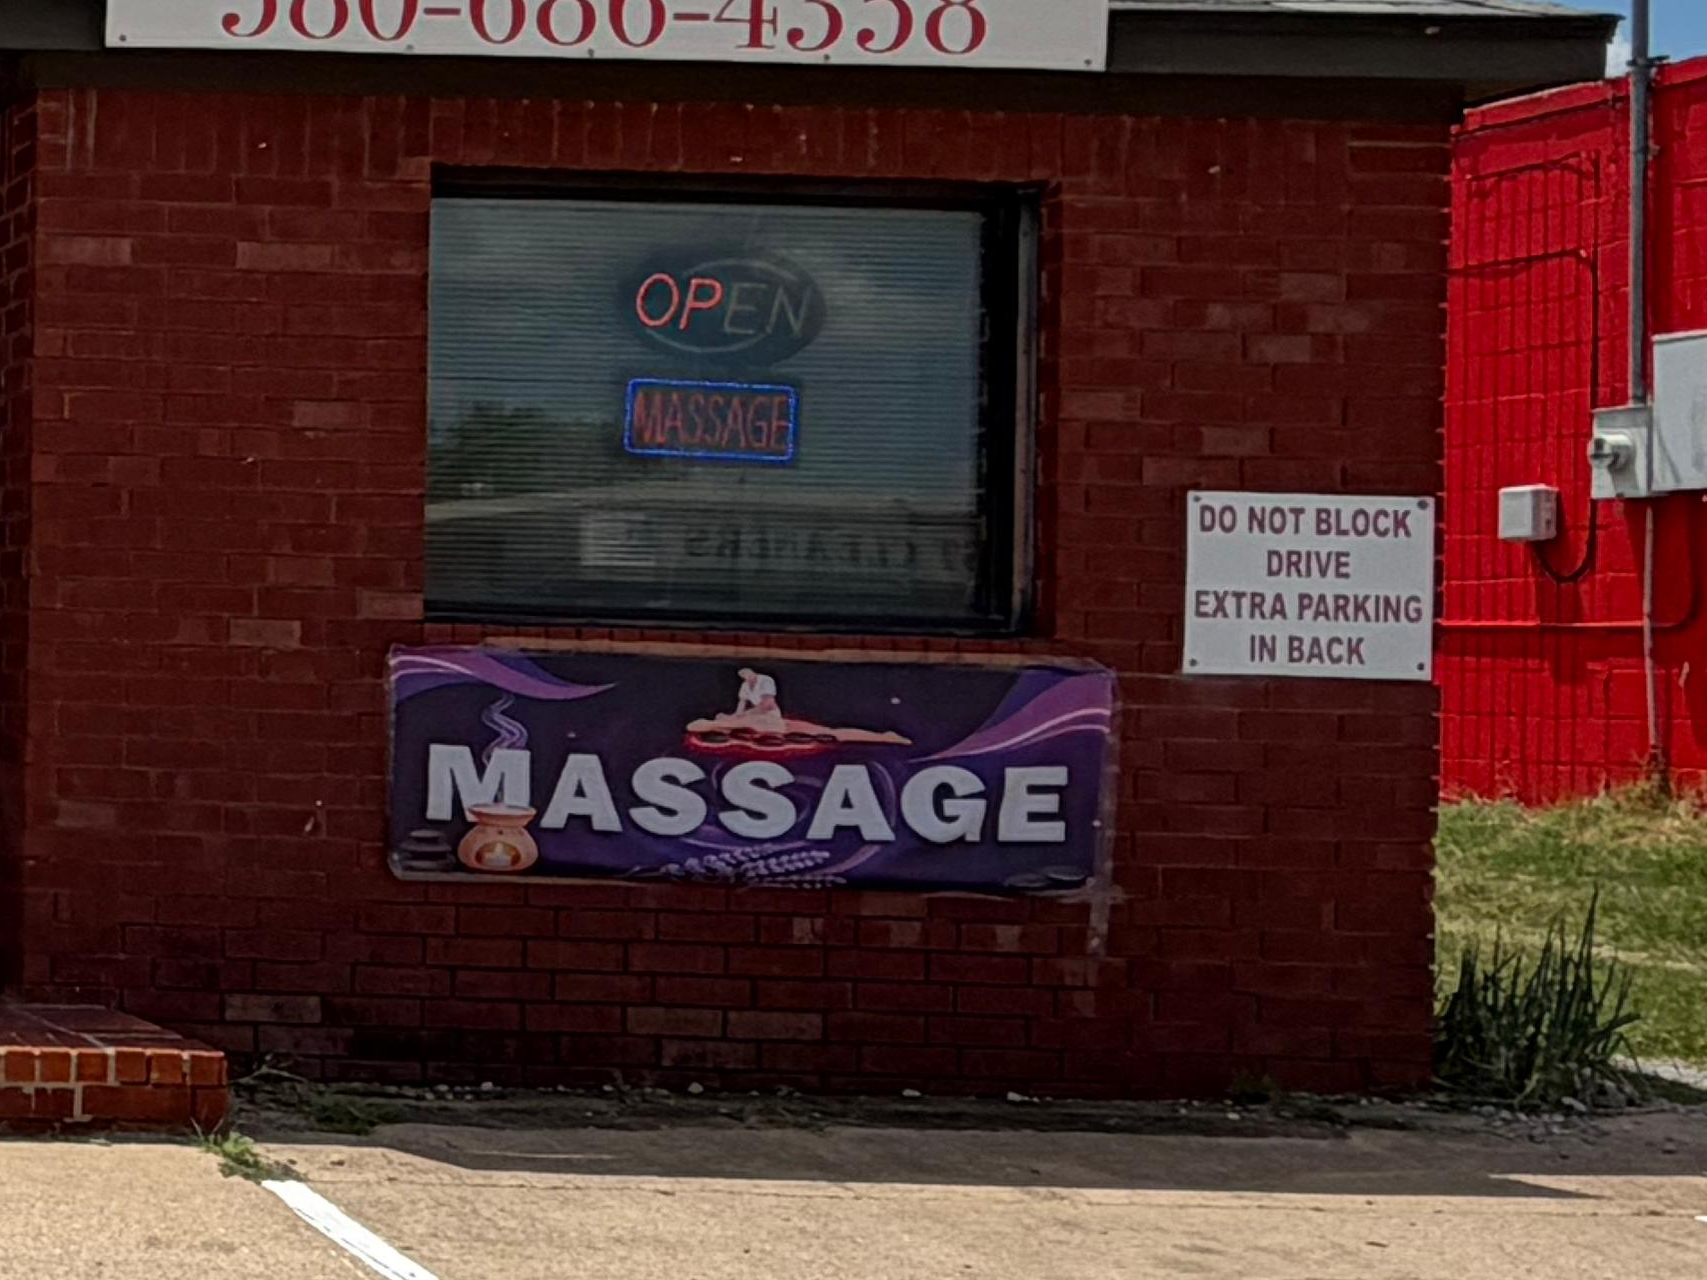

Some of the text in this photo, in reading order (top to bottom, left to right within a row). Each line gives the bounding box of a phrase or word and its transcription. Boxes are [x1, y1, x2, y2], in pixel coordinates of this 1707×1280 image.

[635, 272, 813, 337] OPEN
[633, 388, 789, 450] MASSAGE
[1198, 505, 1413, 539] DO NOT BLOCK
[1265, 549, 1353, 580] DRIVE
[1193, 589, 1423, 625] EXTRA PARKING
[1248, 633, 1366, 666] IN BACK
[425, 743, 1070, 845] MASSAGE
